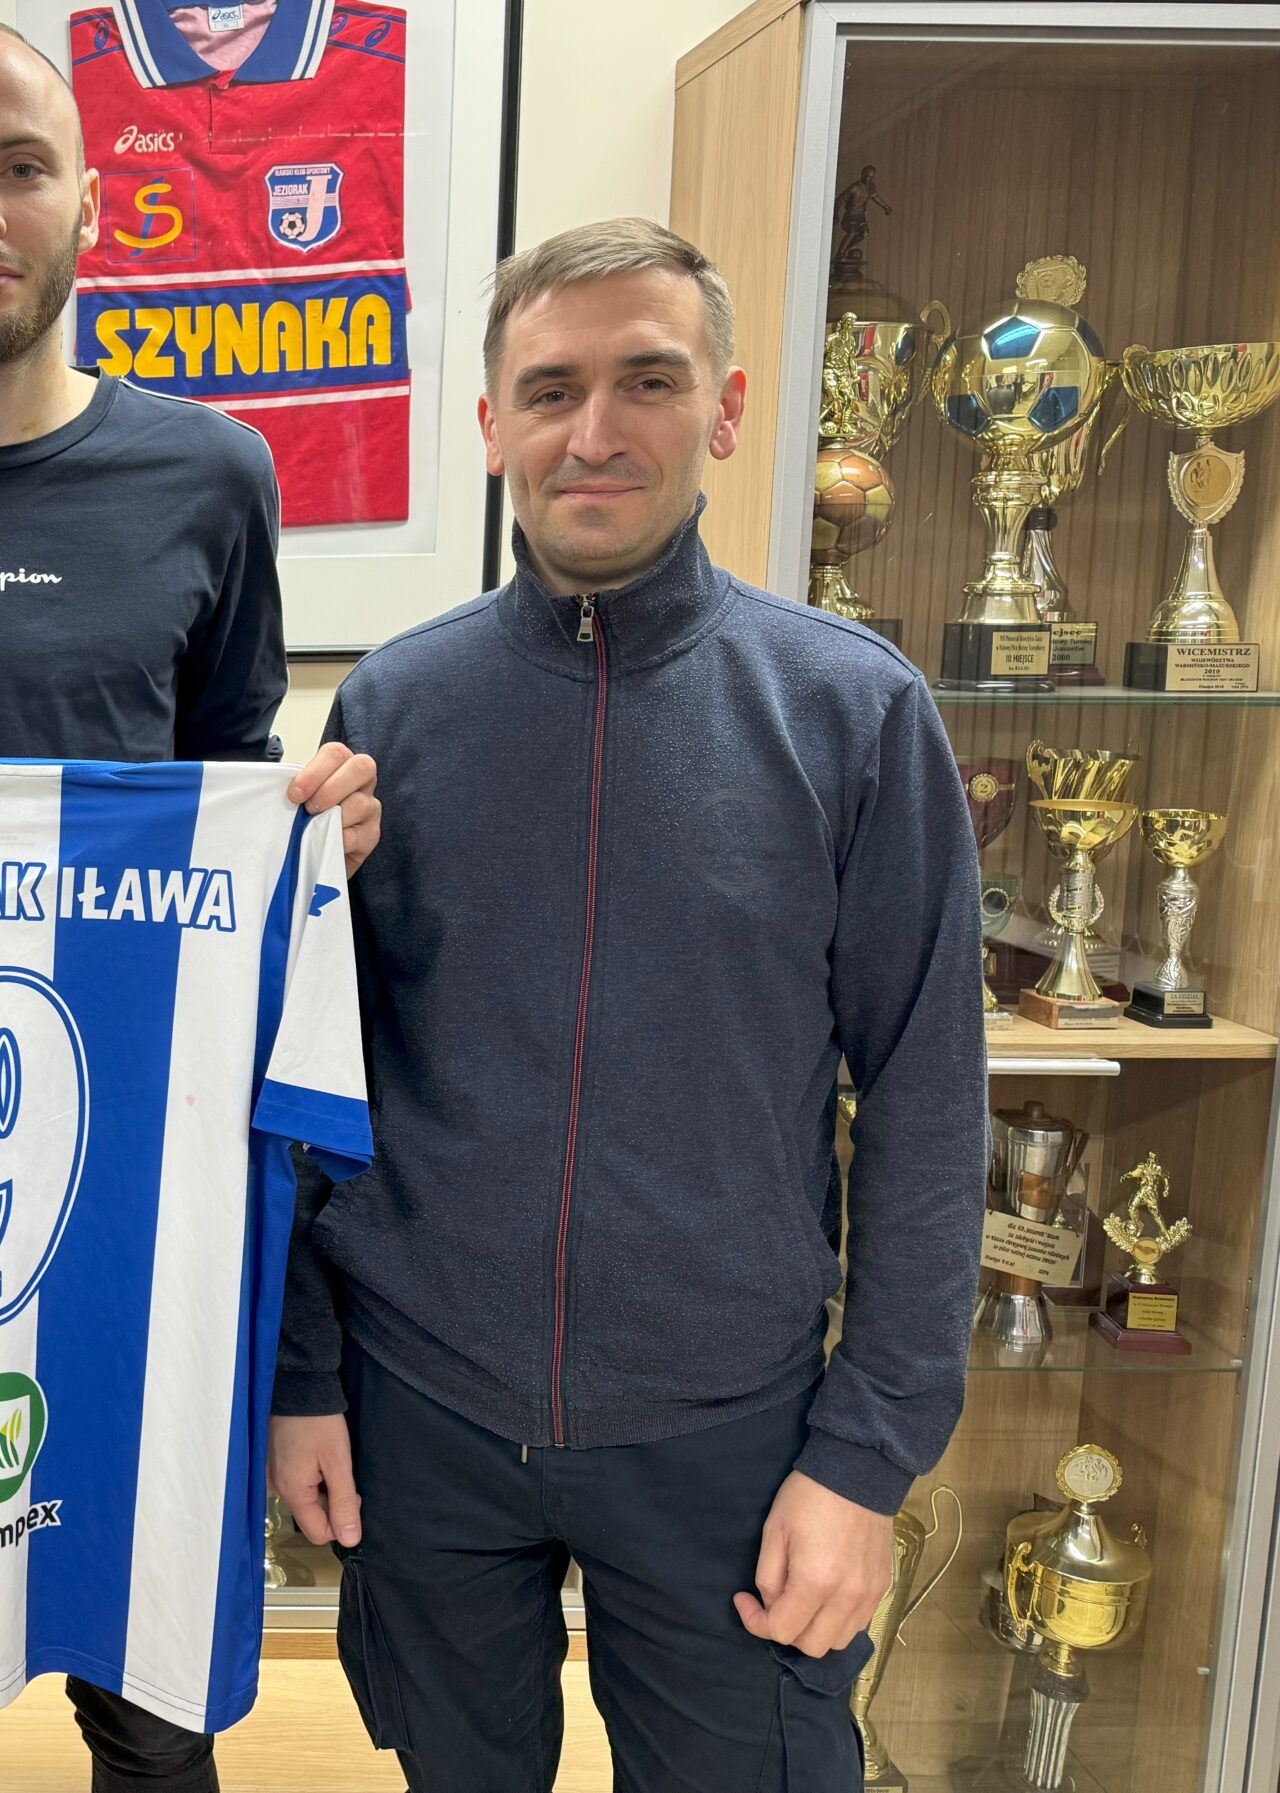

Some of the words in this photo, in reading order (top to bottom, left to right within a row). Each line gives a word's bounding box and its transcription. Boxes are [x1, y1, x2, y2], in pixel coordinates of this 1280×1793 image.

[273, 183, 308, 196] JEZIORAK
[95, 294, 391, 378] SZYNAKA
[1176, 647, 1251, 656] WICEMISTRZ
[1013, 654, 1034, 664] MIEJSCE
[59, 866, 237, 933] IŁAWA
